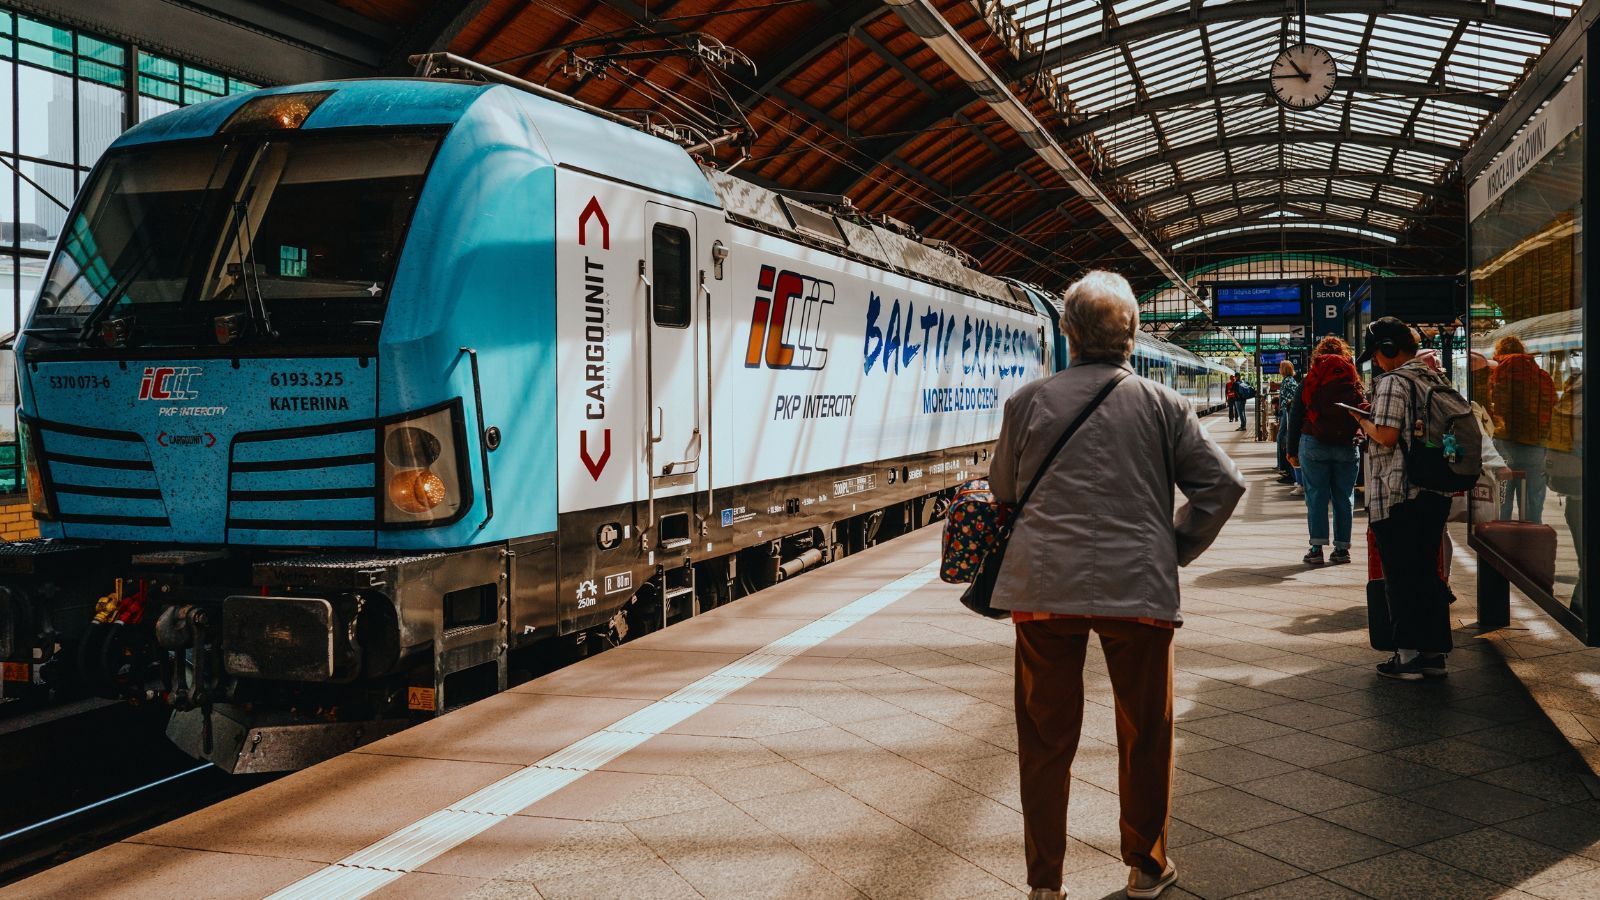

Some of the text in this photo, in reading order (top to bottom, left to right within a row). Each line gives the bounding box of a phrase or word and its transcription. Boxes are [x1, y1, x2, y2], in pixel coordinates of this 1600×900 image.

[1516, 117, 1548, 172] GŁÓWNY
[1325, 304, 1337, 319] B
[584, 255, 604, 420] CARGOUNIT
[863, 290, 1027, 380] BALTIC EXPRESS
[50, 376, 110, 389] 5370 073-6
[270, 371, 344, 387] 6193.325
[270, 396, 350, 411] KATERINA
[923, 381, 998, 414] MORZE AŻ DO CZECH
[158, 405, 228, 417] PKP INTERCITY
[774, 394, 857, 421] PKP INTERCITY
[607, 578, 612, 590] R
[578, 597, 596, 609] 250m
